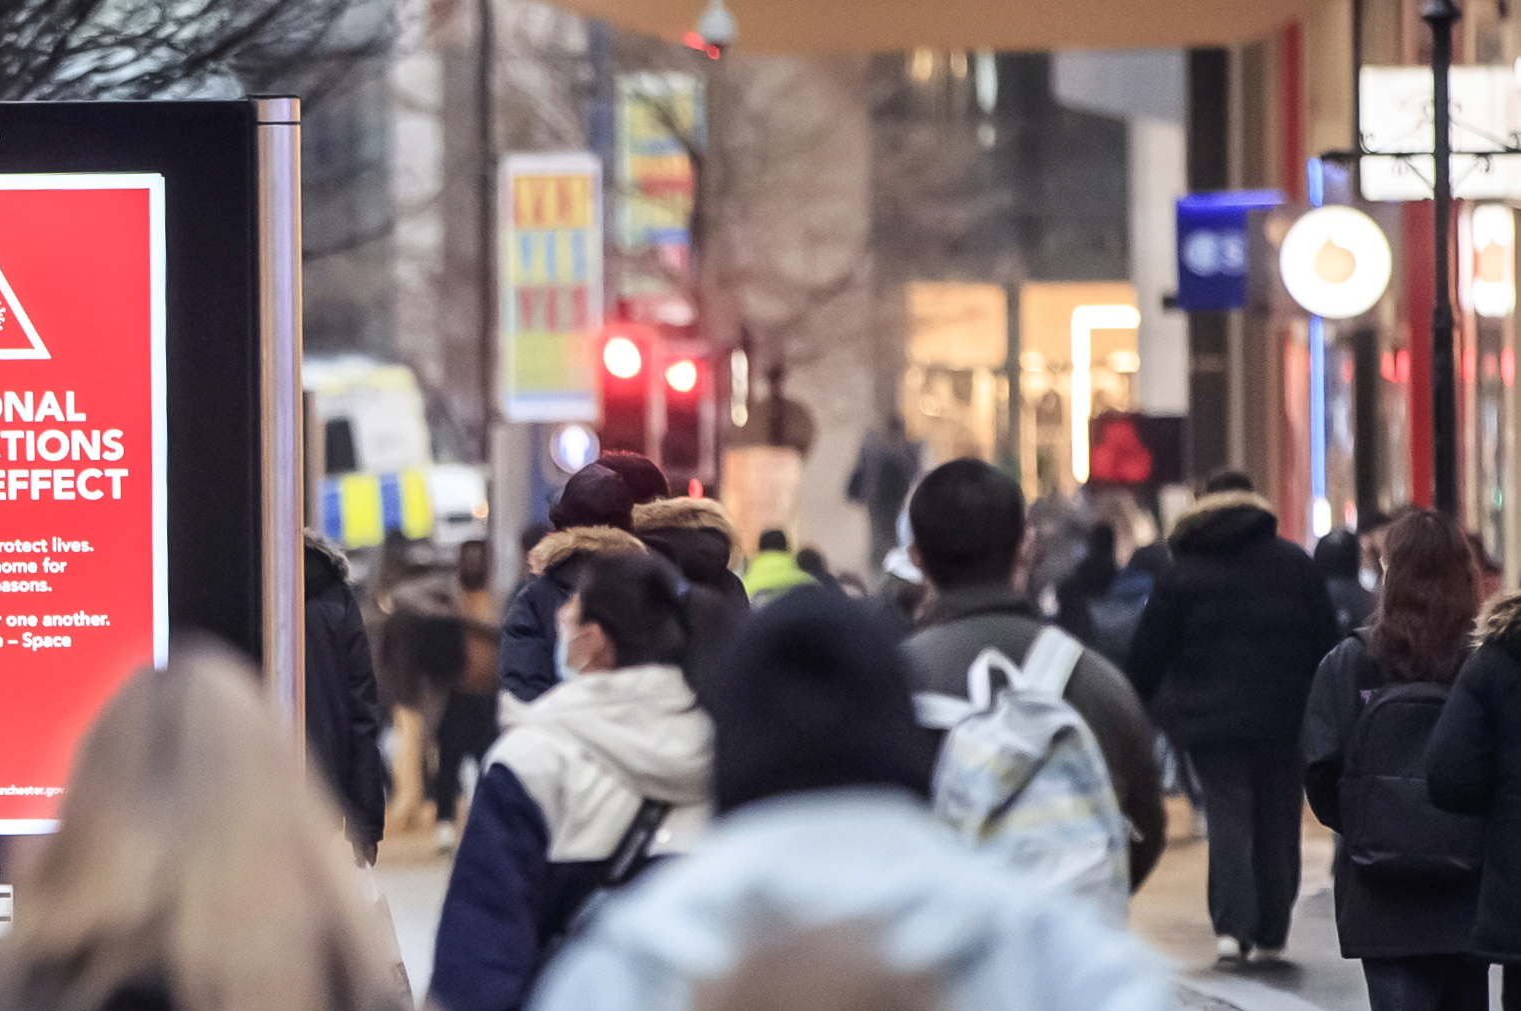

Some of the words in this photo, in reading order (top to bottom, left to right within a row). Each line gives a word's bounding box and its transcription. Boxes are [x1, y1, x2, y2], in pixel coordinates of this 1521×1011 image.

[52, 537, 94, 552] lives.
[43, 557, 67, 573] for
[6, 615, 38, 627] one
[42, 610, 110, 627] another.
[22, 632, 71, 651] Space
